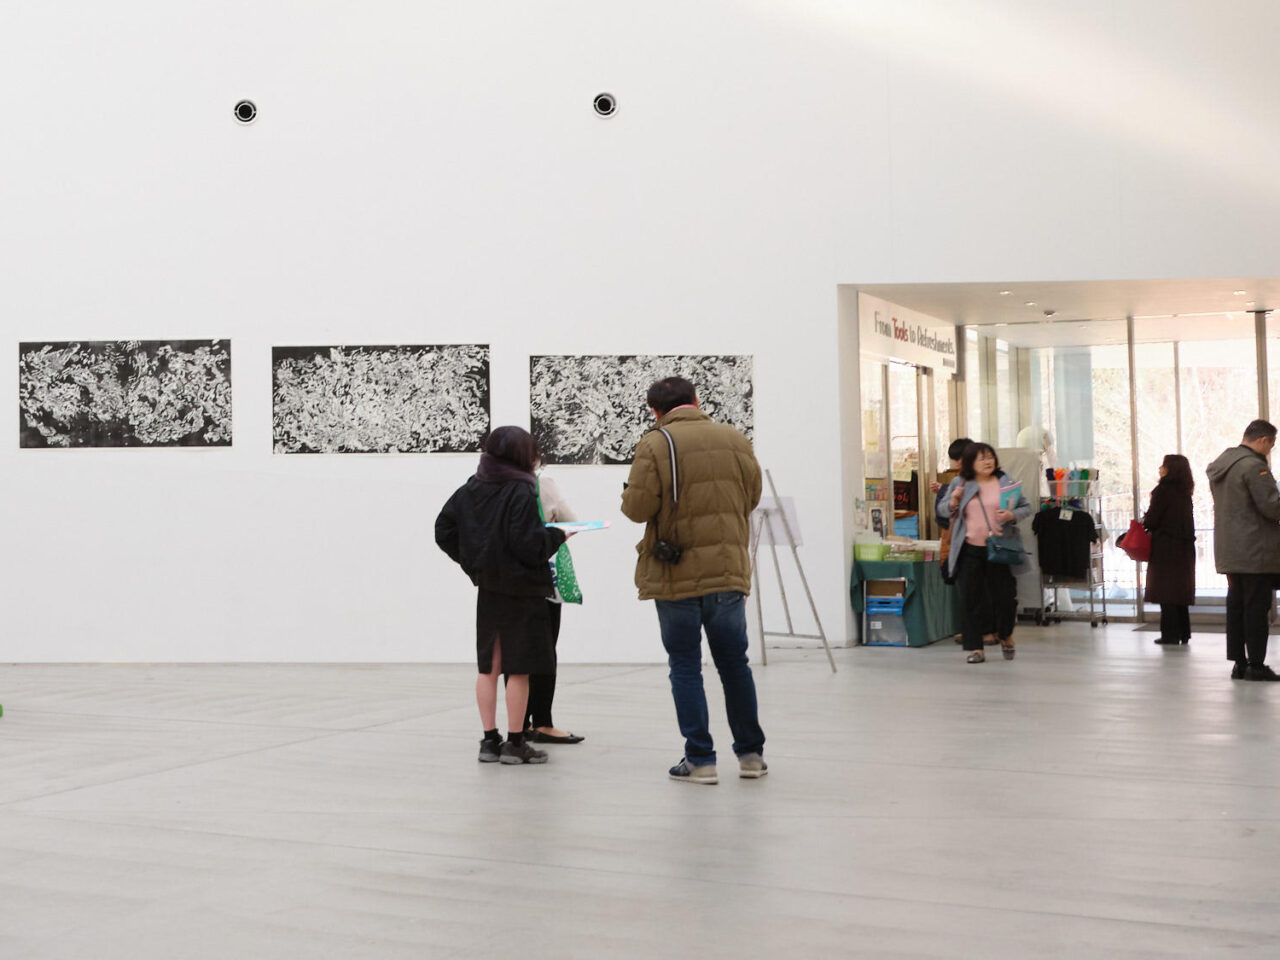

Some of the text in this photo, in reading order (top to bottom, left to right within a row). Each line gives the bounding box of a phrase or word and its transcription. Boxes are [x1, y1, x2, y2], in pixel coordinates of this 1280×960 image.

[874, 310, 892, 338] From
[892, 317, 909, 342] Tools
[909, 325, 917, 343] to
